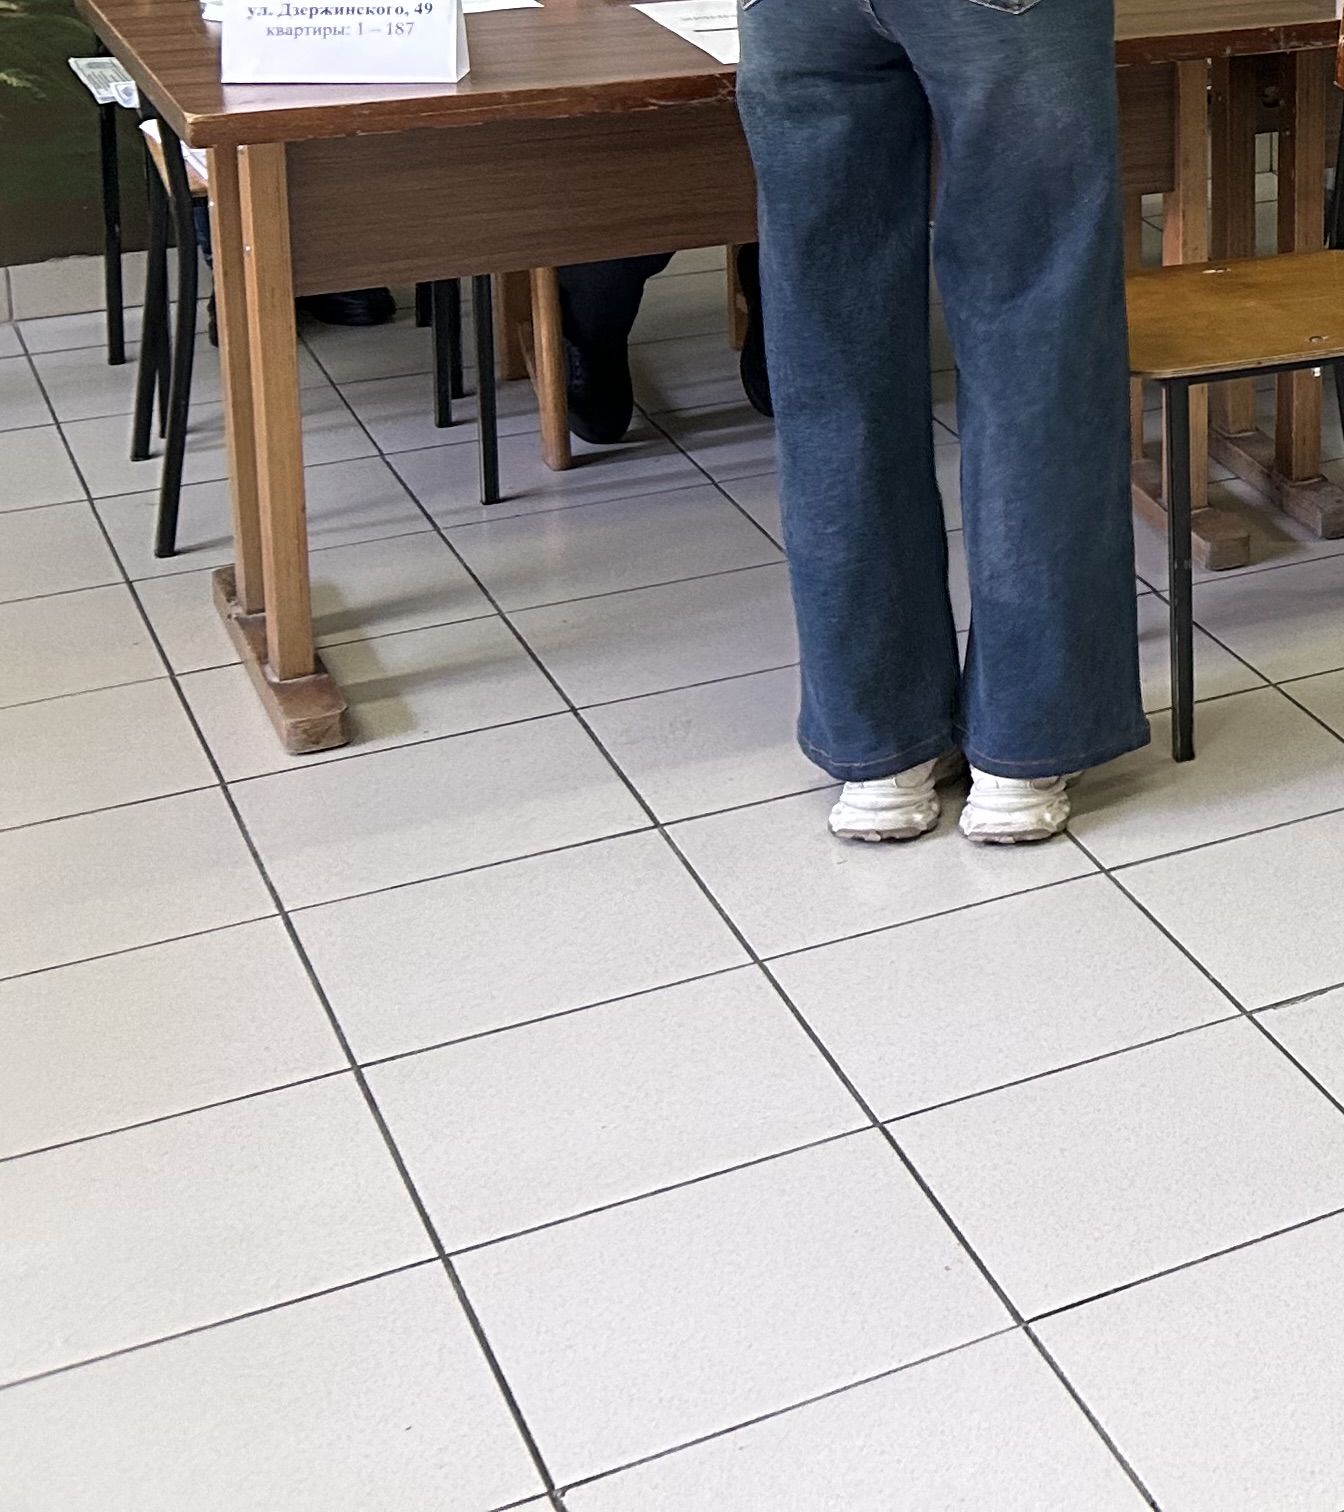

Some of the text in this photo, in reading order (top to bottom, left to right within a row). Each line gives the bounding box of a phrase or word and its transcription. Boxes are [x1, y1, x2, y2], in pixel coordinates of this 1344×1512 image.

[246, 1, 434, 20] ул. Дзержинского, 49
[266, 24, 352, 39] квартиры:
[357, 22, 364, 36] 1
[387, 22, 415, 37] 187
